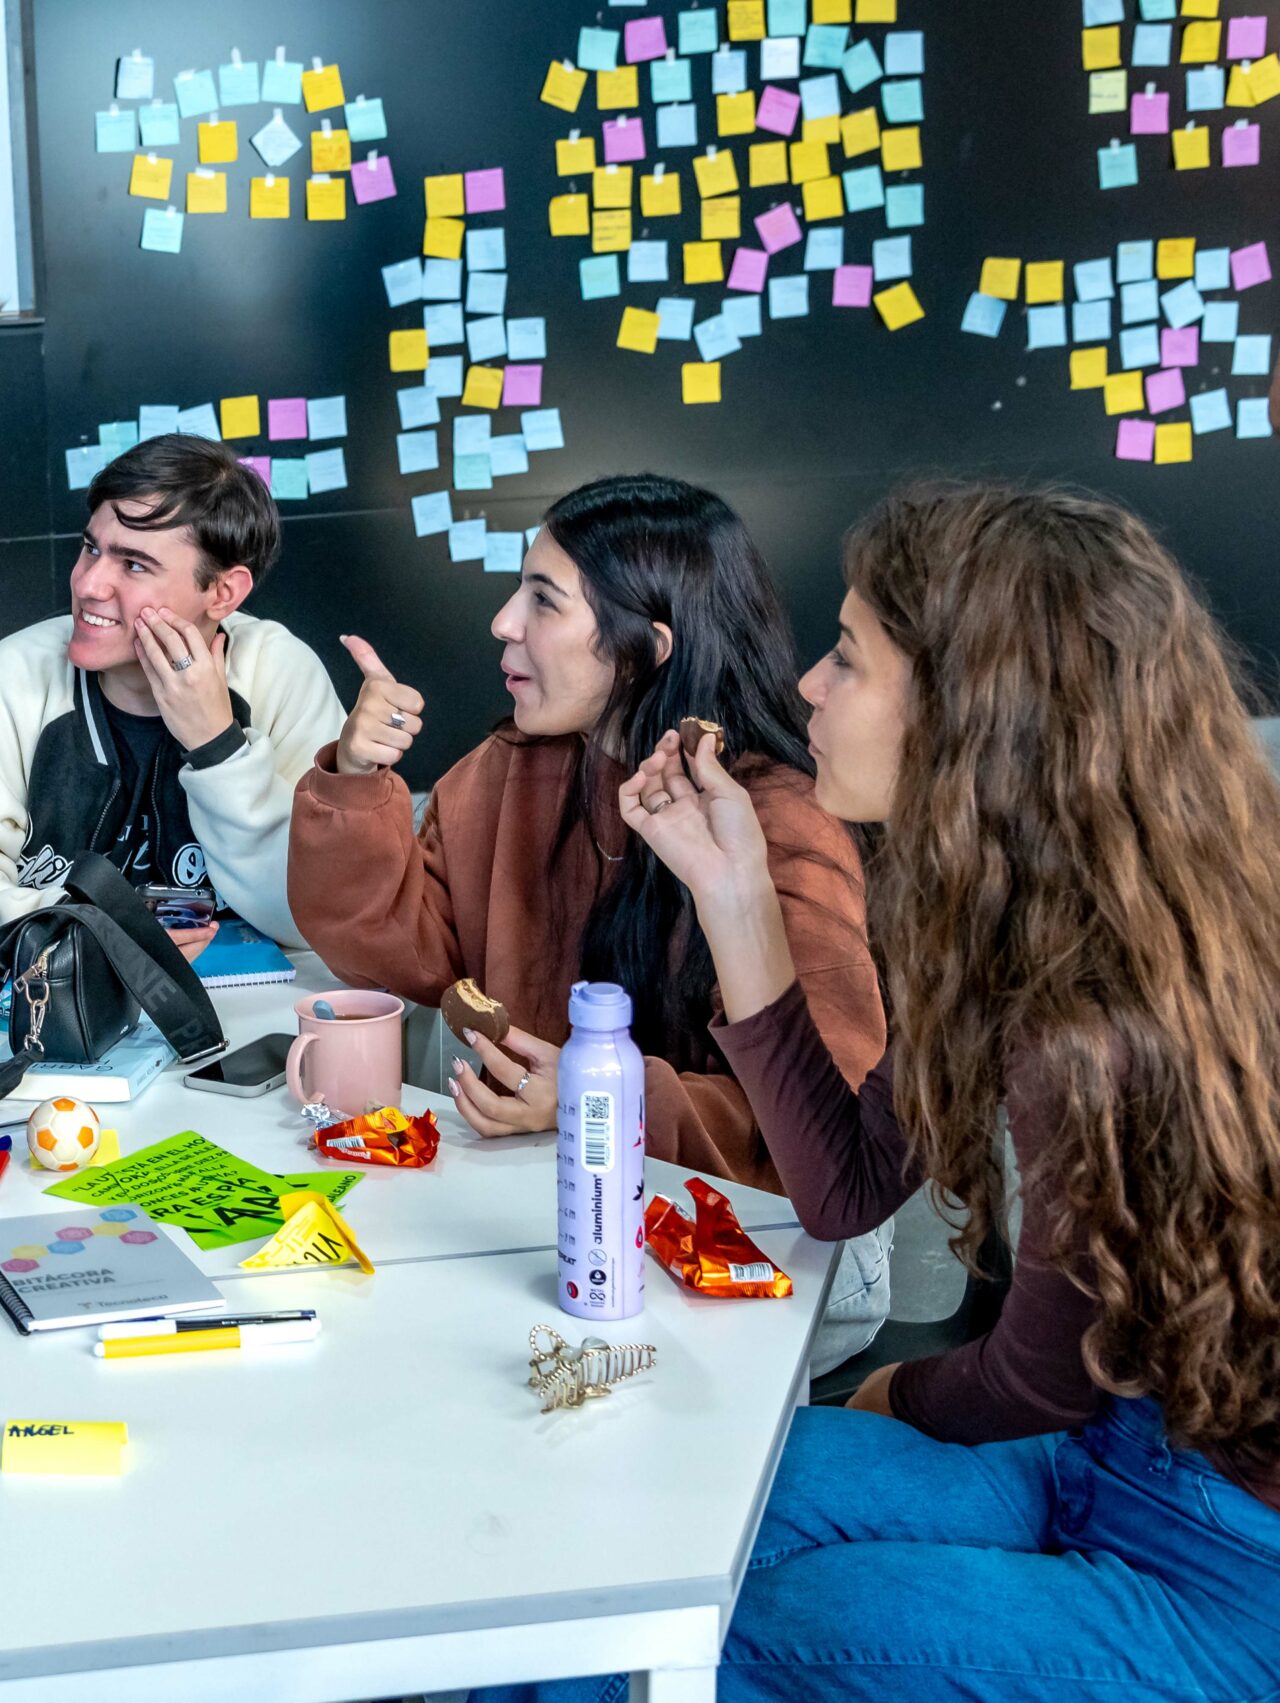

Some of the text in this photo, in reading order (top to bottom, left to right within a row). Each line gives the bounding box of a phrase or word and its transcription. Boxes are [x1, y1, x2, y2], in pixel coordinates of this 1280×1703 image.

[182, 1136, 206, 1149] HO
[12, 1268, 114, 1287] BITÁCORA
[18, 1276, 117, 1294] CREATIVA
